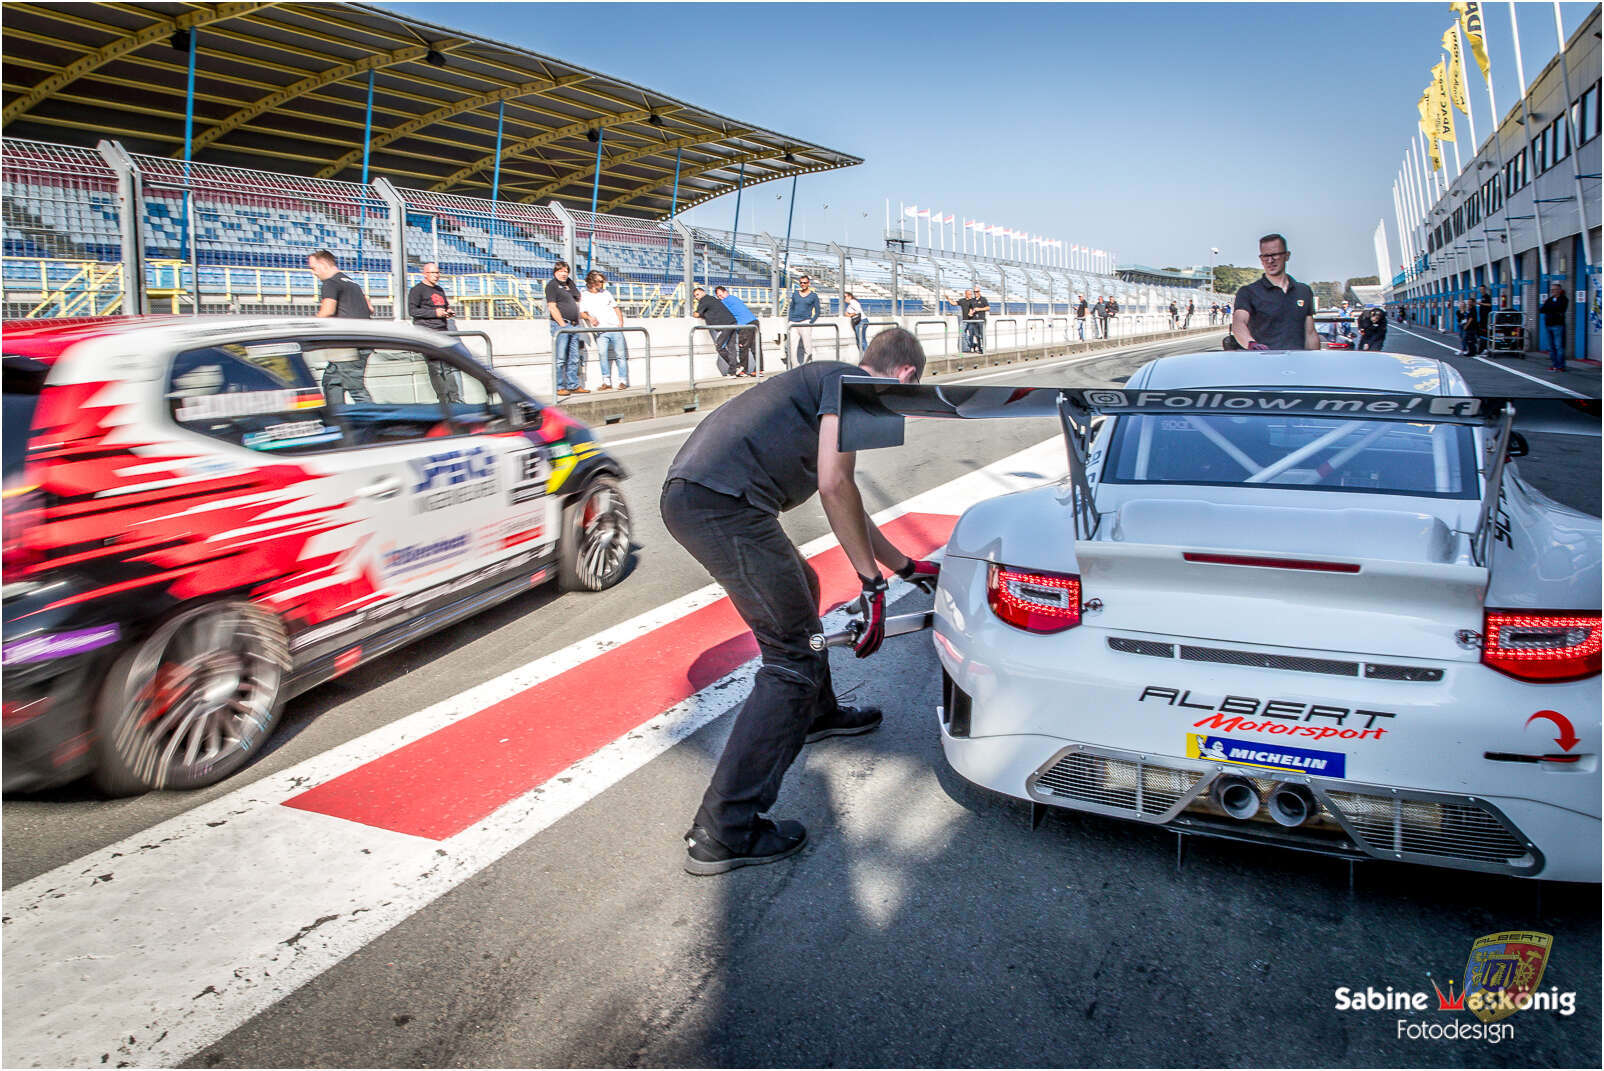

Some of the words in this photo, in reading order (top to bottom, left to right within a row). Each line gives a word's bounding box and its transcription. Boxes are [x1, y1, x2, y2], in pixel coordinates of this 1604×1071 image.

[1136, 391, 1303, 410] Follow
[1313, 397, 1422, 414] me!
[1138, 685, 1397, 729] ALBERT
[1193, 713, 1389, 741] Motorsport
[1229, 747, 1328, 770] MICHELIN
